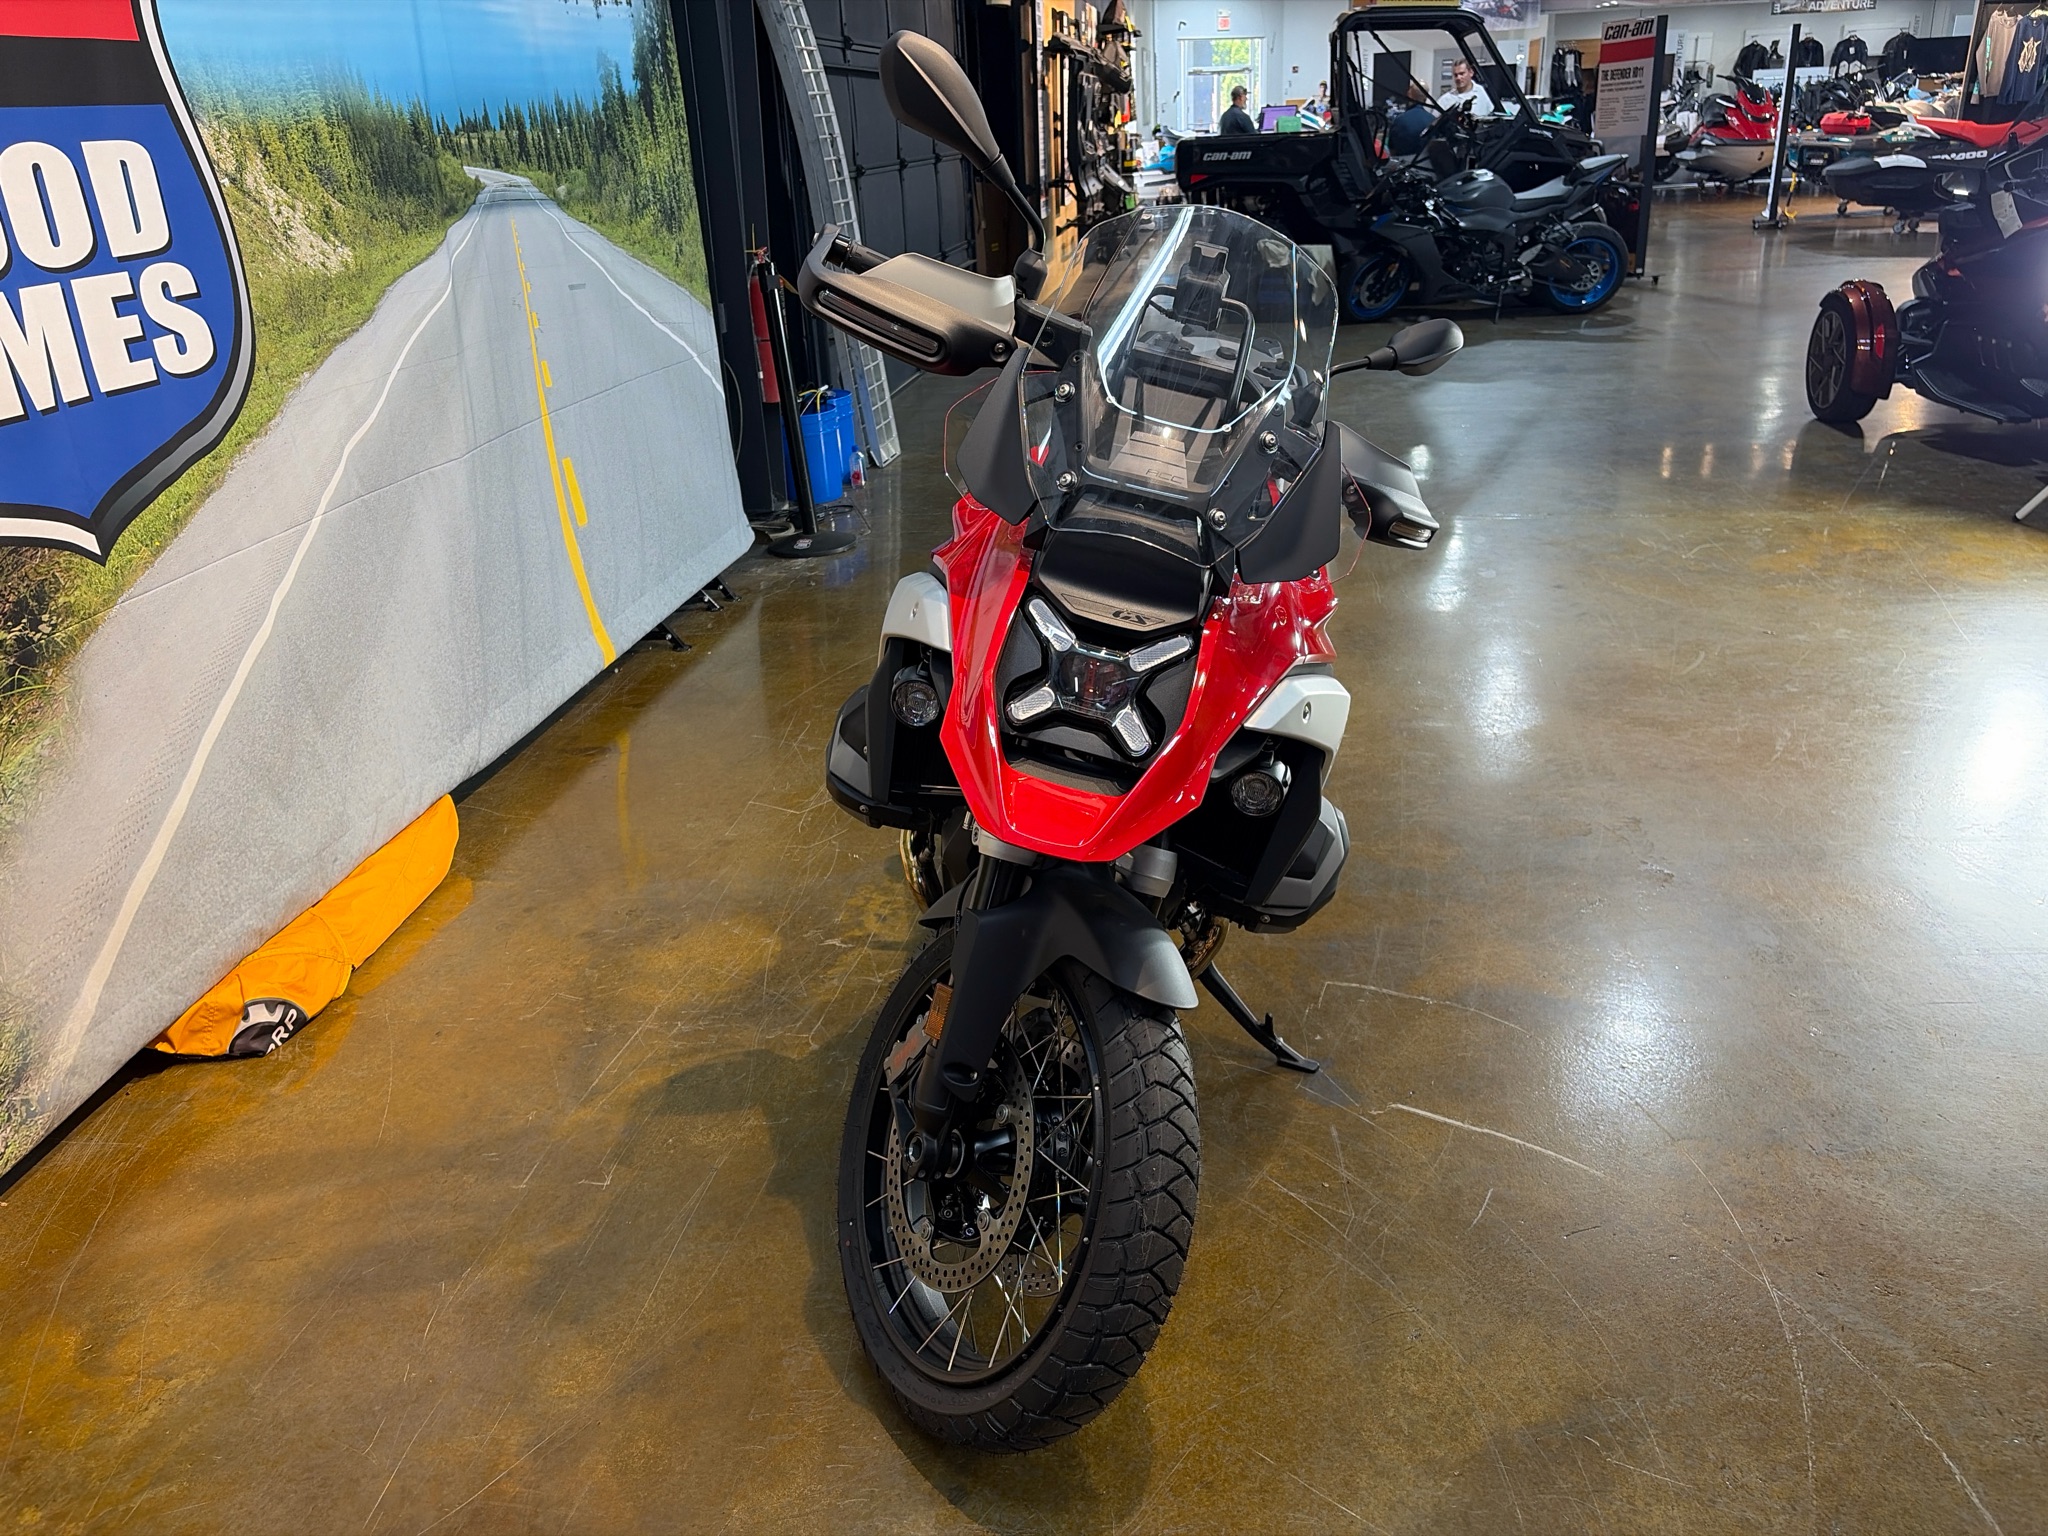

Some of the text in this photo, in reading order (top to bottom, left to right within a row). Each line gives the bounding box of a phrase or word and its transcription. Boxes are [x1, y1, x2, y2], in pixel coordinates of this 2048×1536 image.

[1808, 0, 1874, 12] ADVENTURE
[1604, 18, 1654, 41] can-am
[1203, 151, 1252, 161] can-am
[0, 140, 172, 278] OD
[0, 261, 216, 423] MES
